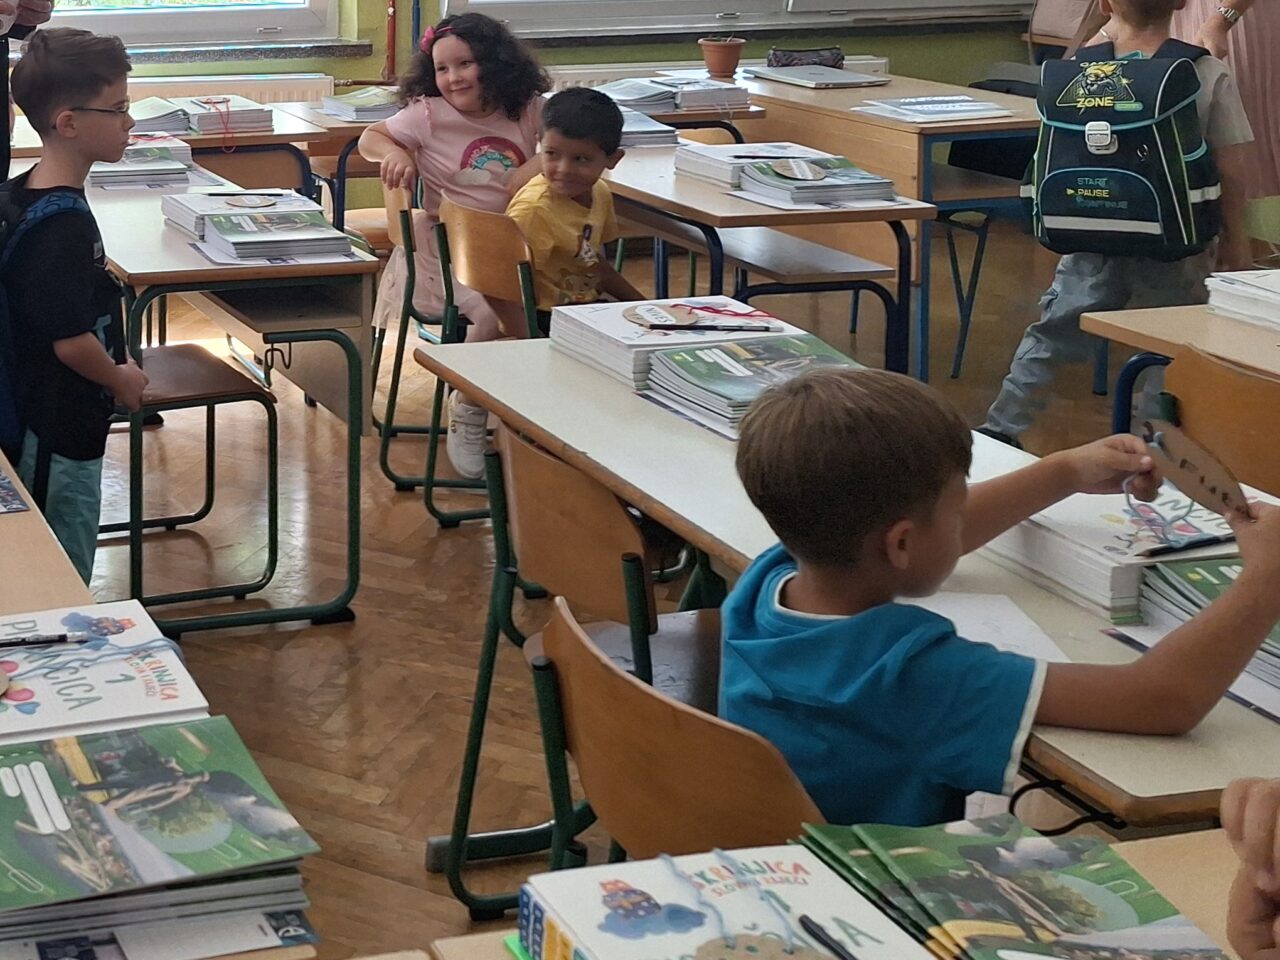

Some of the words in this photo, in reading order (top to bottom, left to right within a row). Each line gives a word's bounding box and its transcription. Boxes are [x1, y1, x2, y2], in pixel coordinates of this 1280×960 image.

[1076, 96, 1114, 108] ZONE
[1077, 177, 1108, 187] START
[1077, 188, 1110, 198] PAUSE
